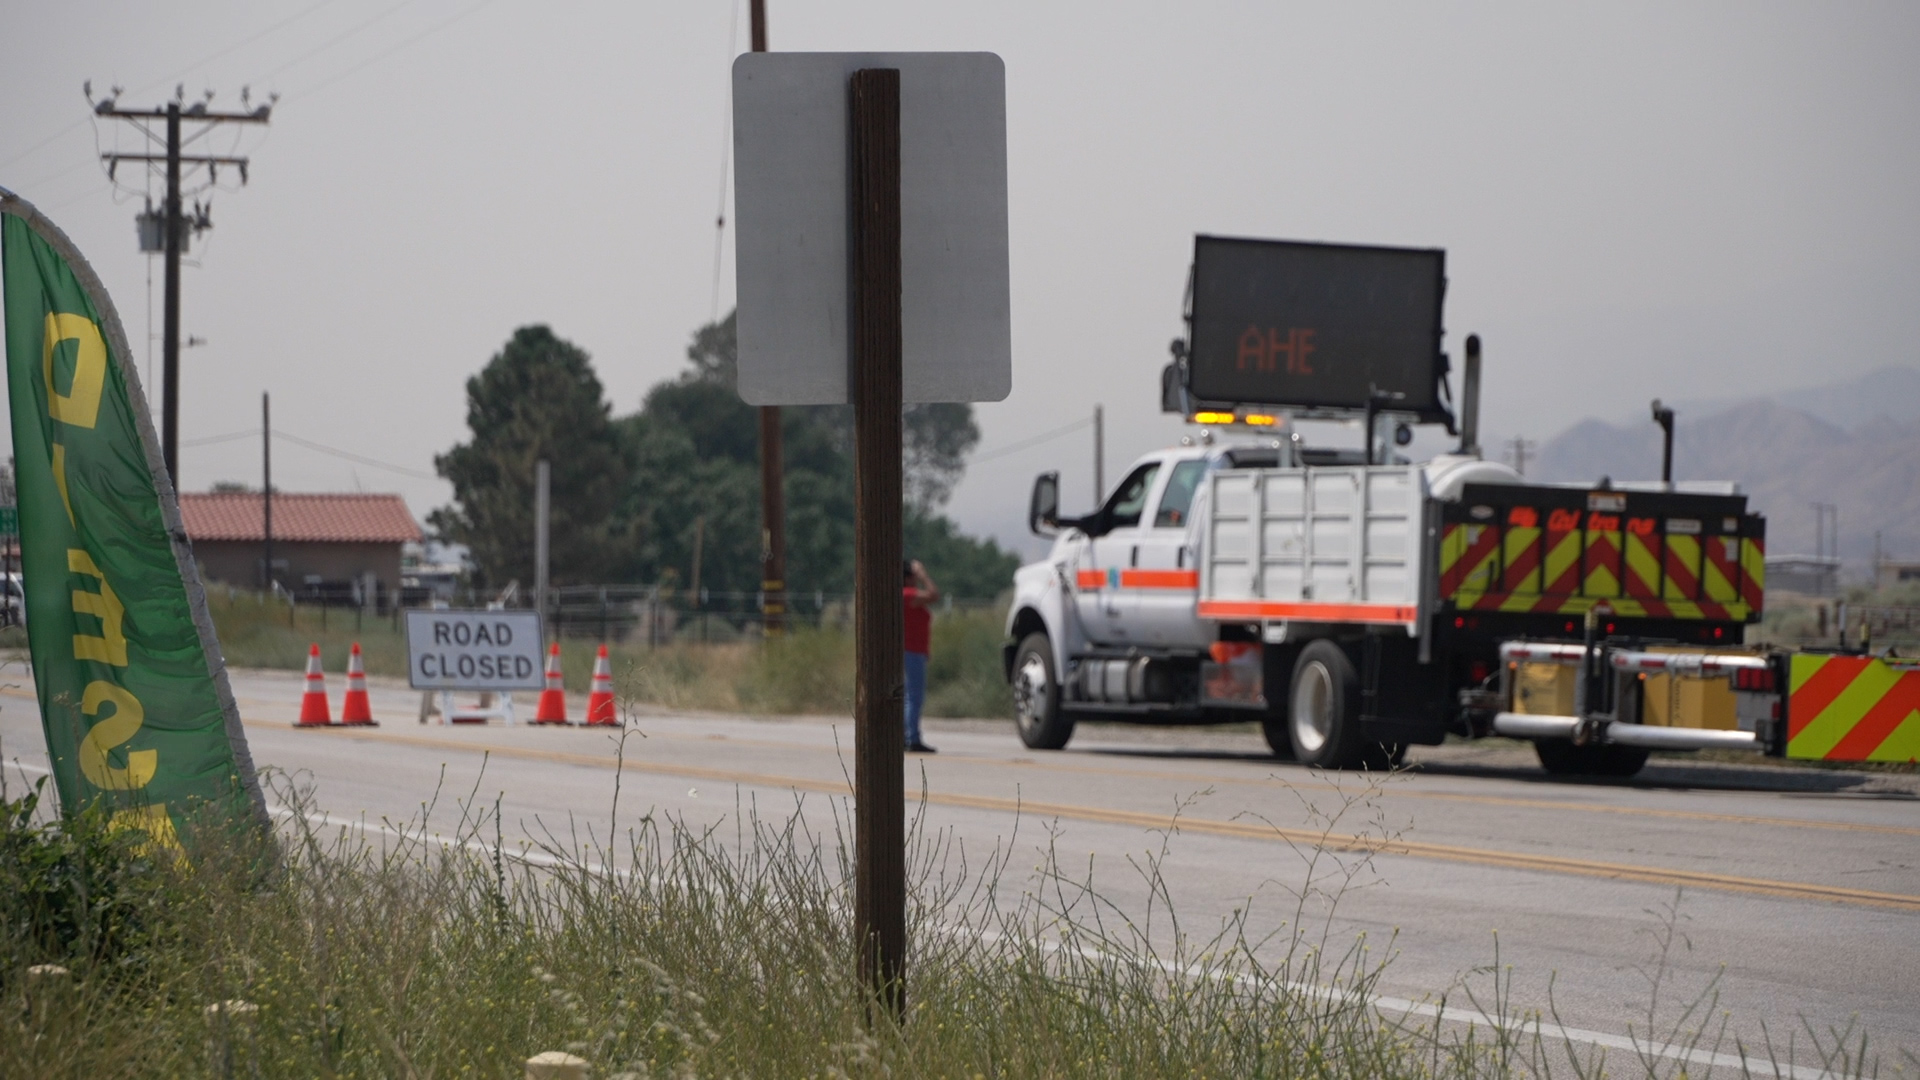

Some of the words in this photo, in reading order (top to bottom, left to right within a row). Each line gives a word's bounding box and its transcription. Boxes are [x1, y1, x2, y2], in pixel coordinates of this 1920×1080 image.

[1236, 325, 1316, 375] AHE
[433, 621, 513, 646] ROAD
[420, 653, 533, 679] CLOSED
